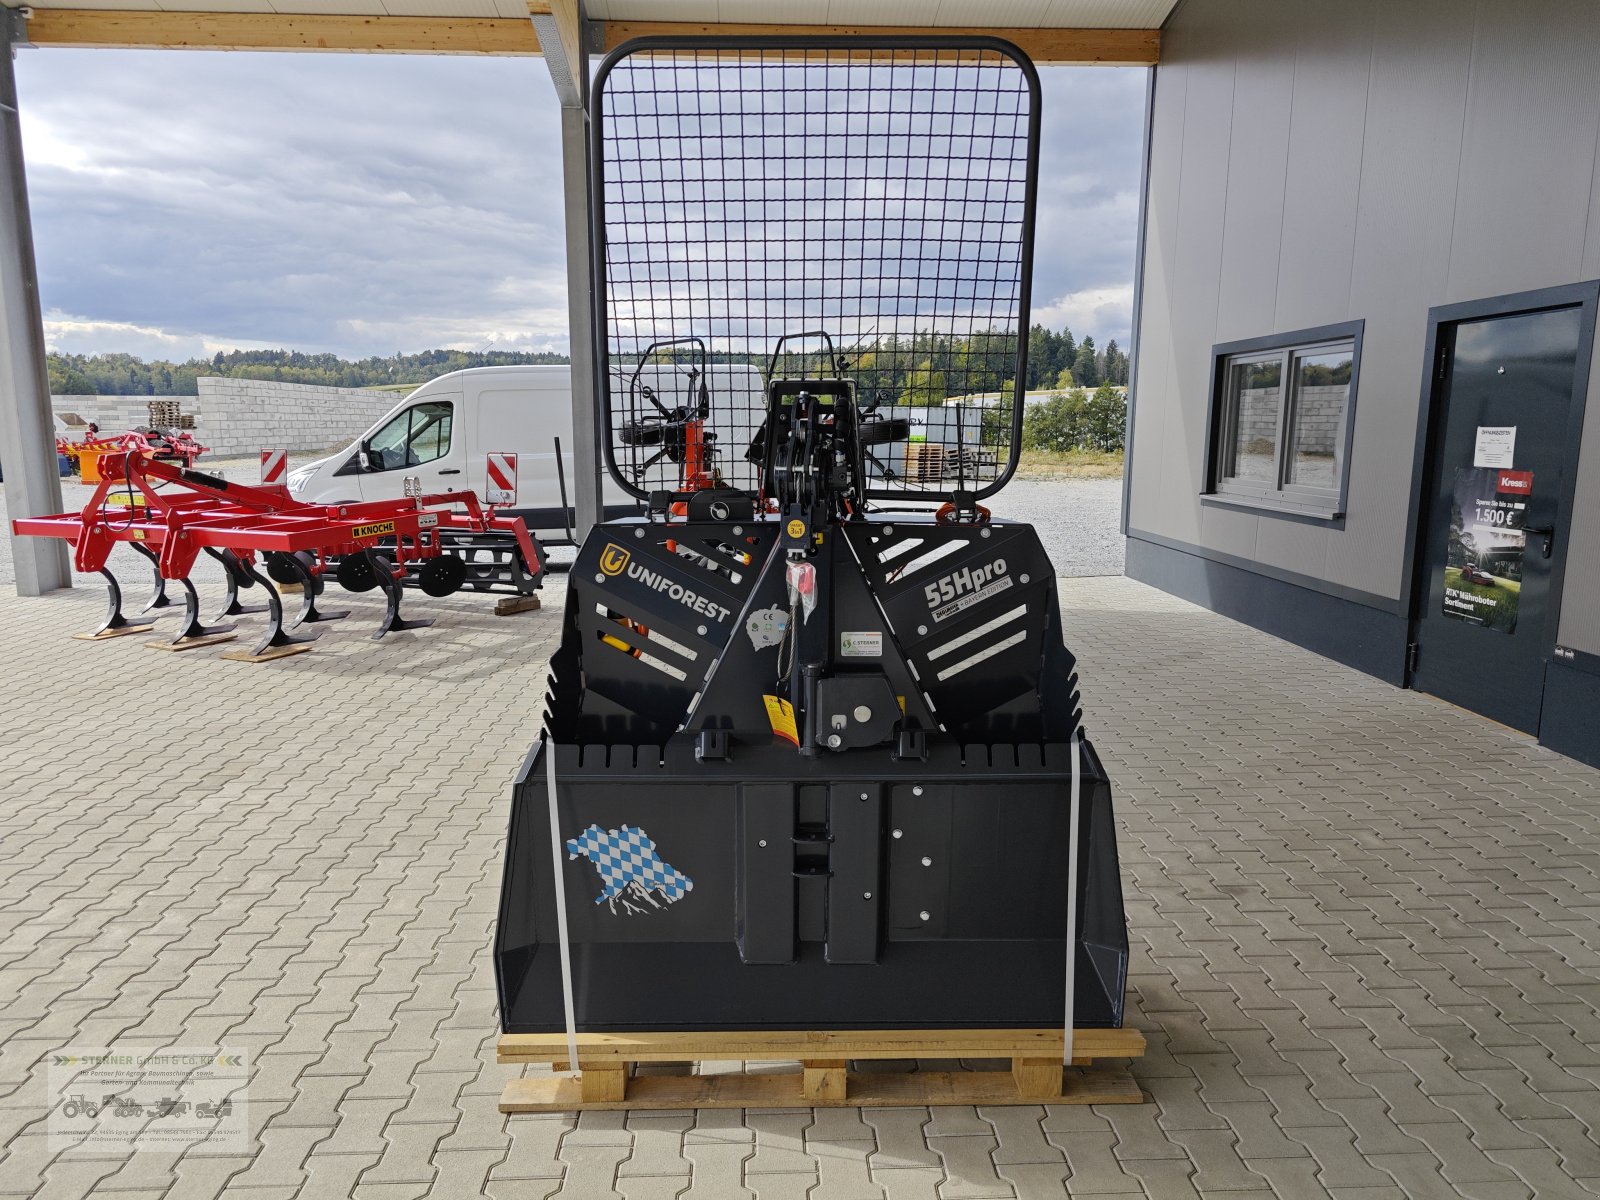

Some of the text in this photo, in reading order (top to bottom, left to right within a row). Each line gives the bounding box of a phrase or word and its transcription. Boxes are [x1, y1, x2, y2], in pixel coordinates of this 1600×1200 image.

[1501, 477, 1523, 487] Kress
[1475, 508, 1514, 525] 1.500 €
[361, 522, 394, 536] KNOCHE
[627, 561, 731, 623] UNIFOREST
[924, 558, 1007, 609] 55Hpro
[964, 580, 1010, 606] BAYERN EDITION
[1459, 590, 1497, 607] Mähroboter
[1444, 596, 1474, 611] Sortiment
